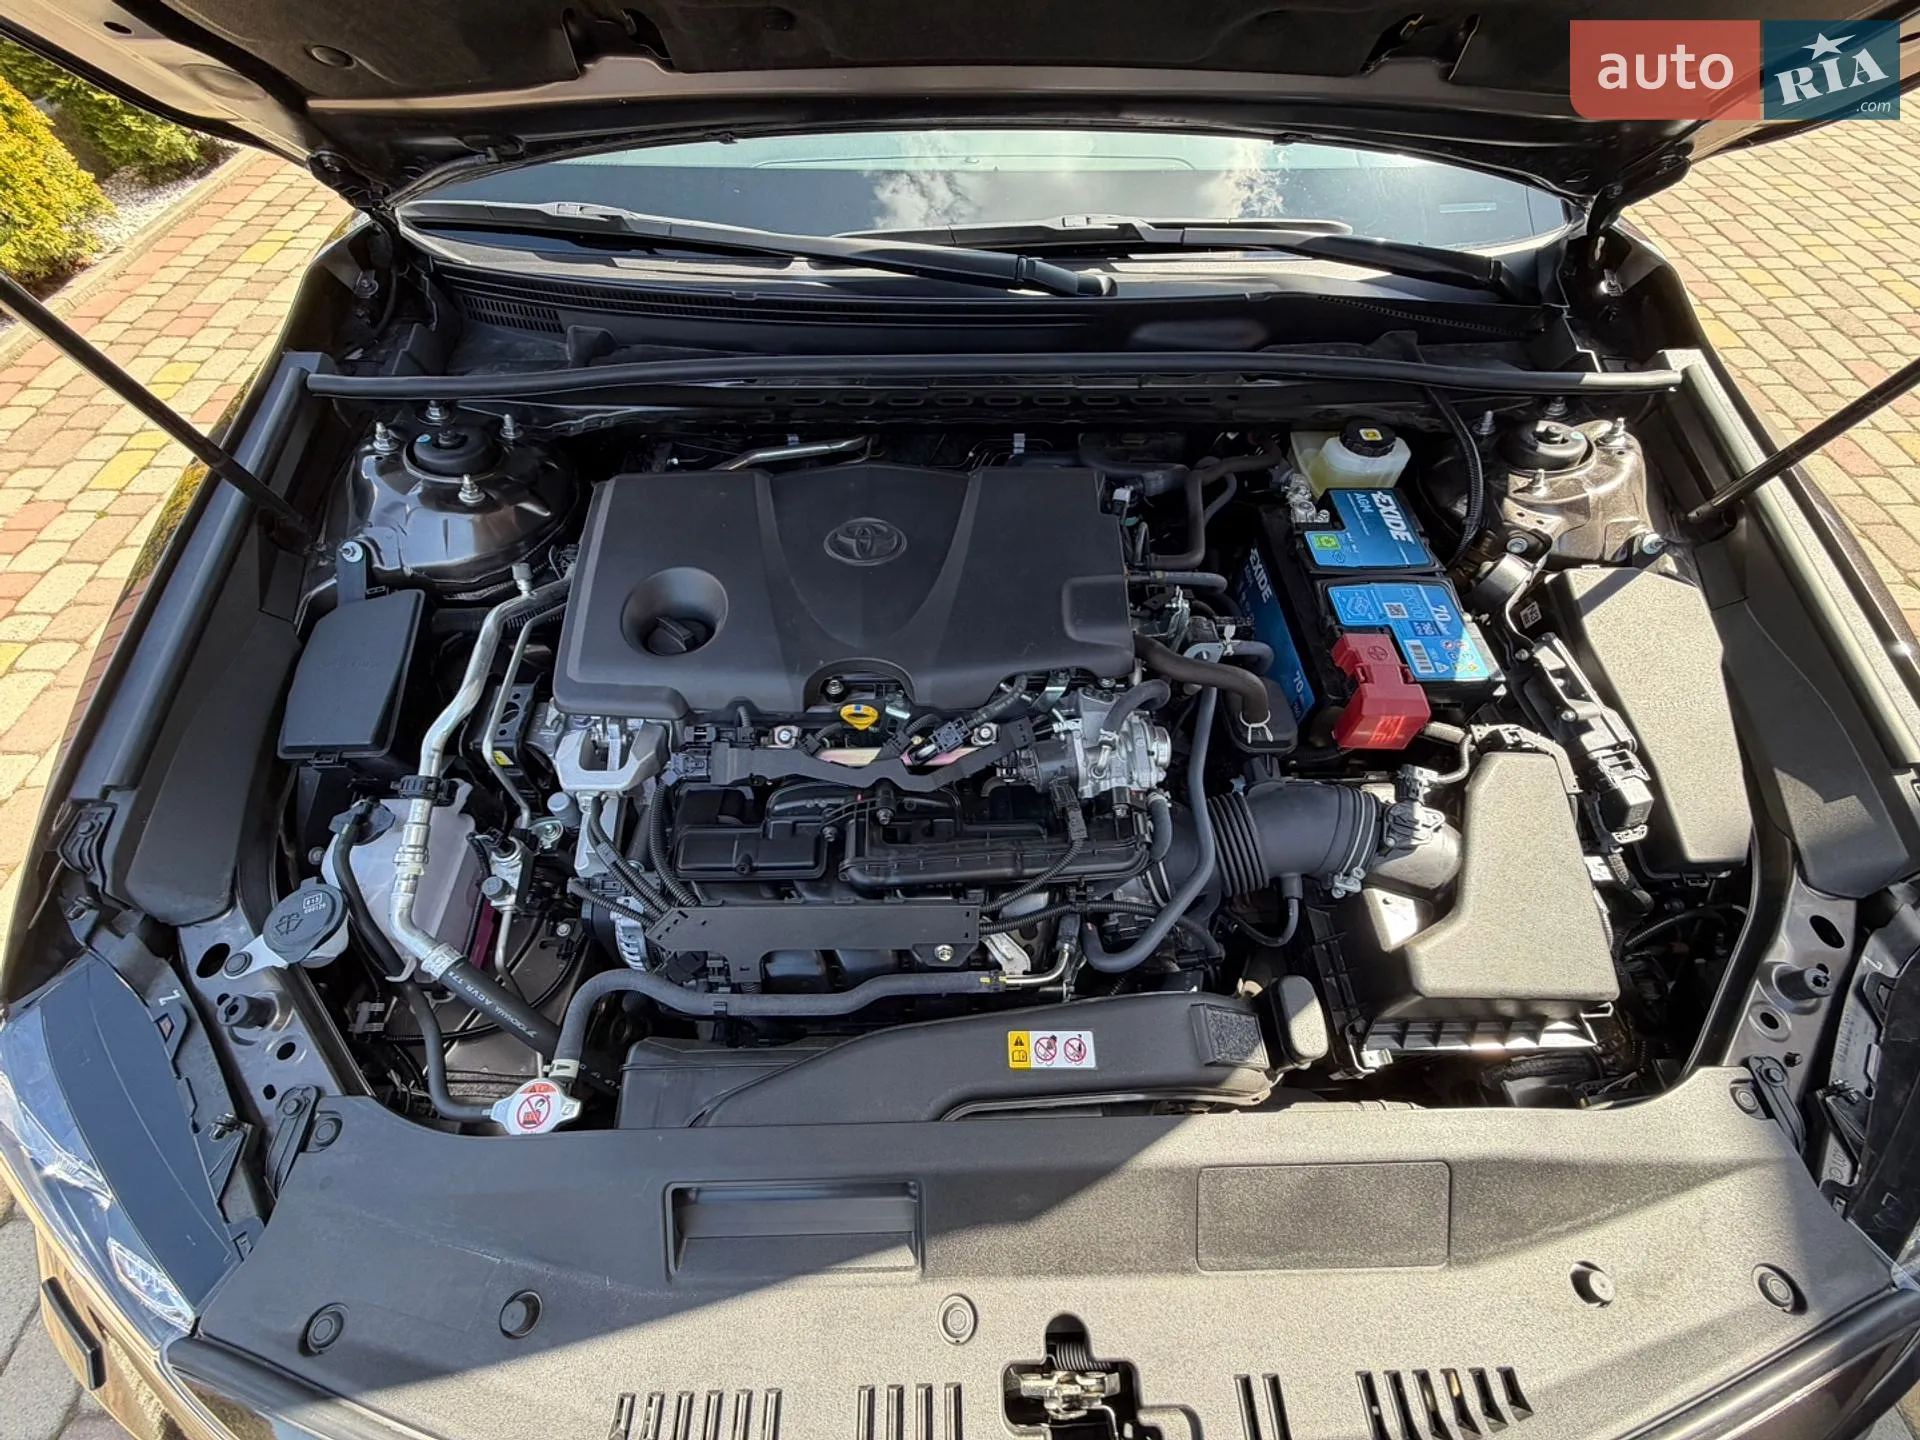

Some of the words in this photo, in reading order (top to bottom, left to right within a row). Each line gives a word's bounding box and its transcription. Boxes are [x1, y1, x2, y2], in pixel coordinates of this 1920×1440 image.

[1353, 492, 1372, 513] AGM
[1371, 490, 1414, 545] EXIDE
[1249, 548, 1272, 603] EXIDE
[1432, 604, 1452, 621] 70
[1293, 670, 1304, 693] 70
